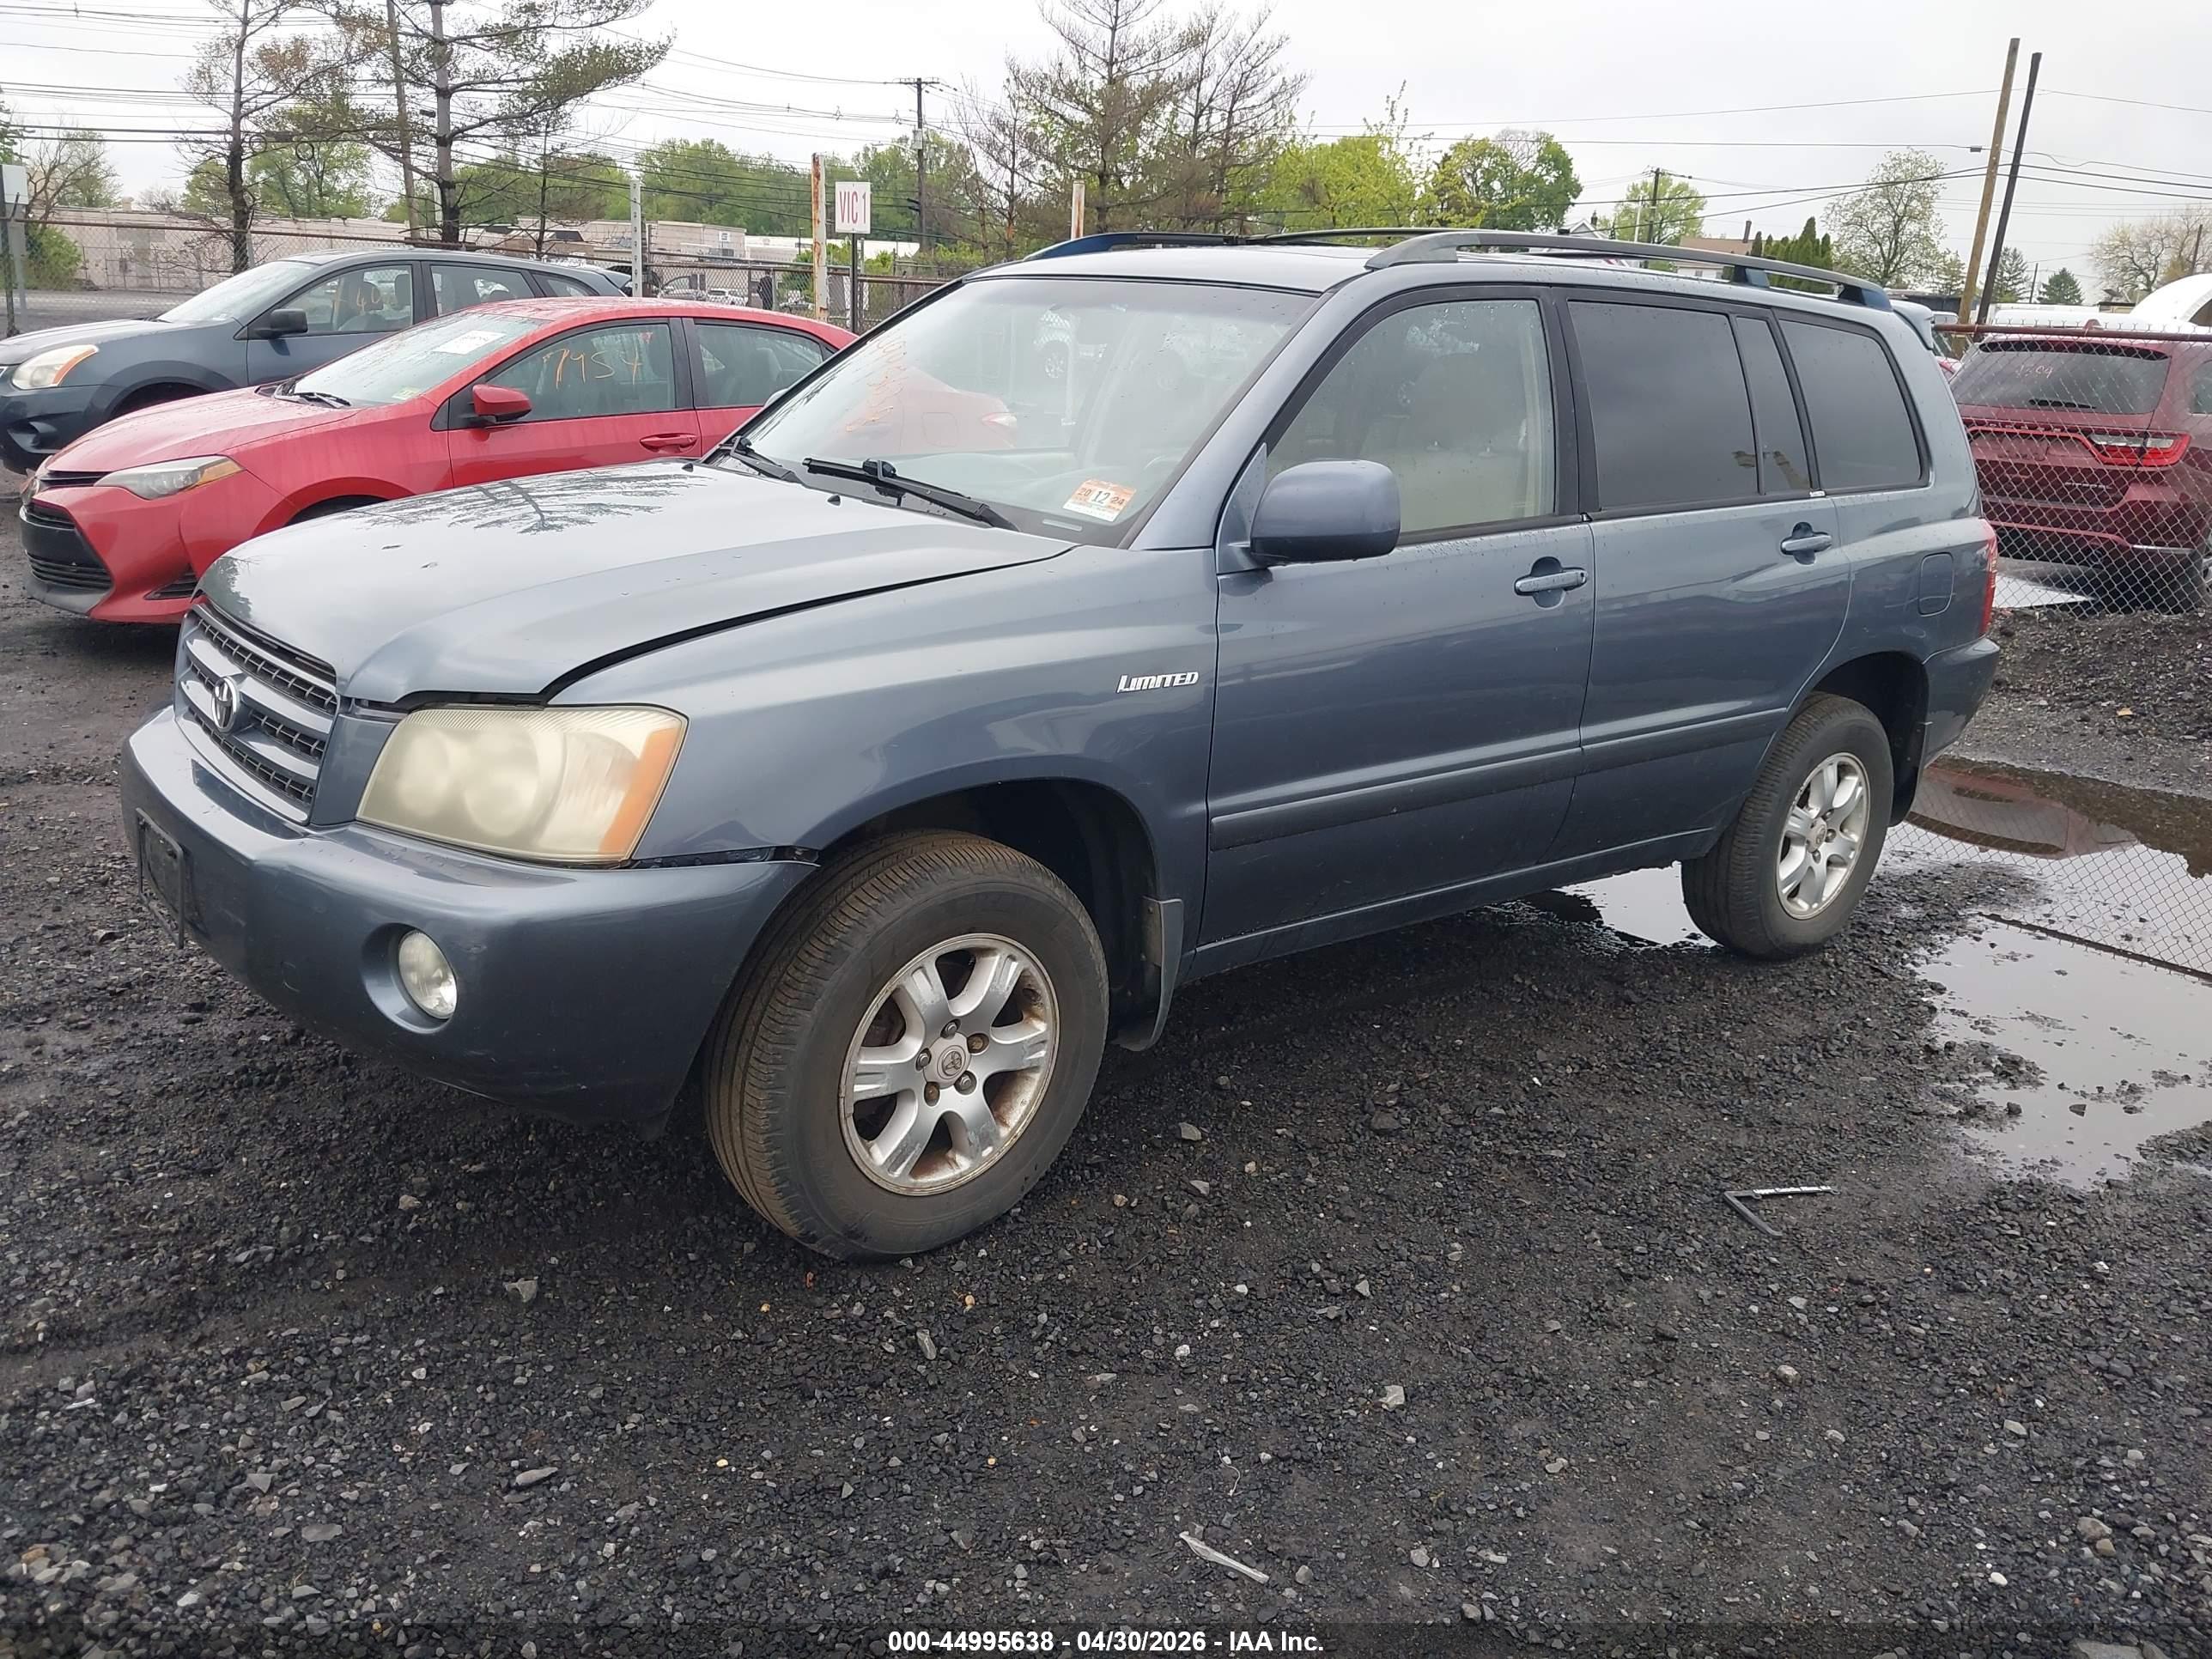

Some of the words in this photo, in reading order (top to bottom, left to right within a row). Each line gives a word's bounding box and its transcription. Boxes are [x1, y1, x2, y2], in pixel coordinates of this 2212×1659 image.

[839, 191, 858, 223] VIC
[861, 191, 867, 224] 1
[1078, 487, 1092, 497] 20
[1091, 490, 1111, 505] 12
[1110, 496, 1125, 505] 24
